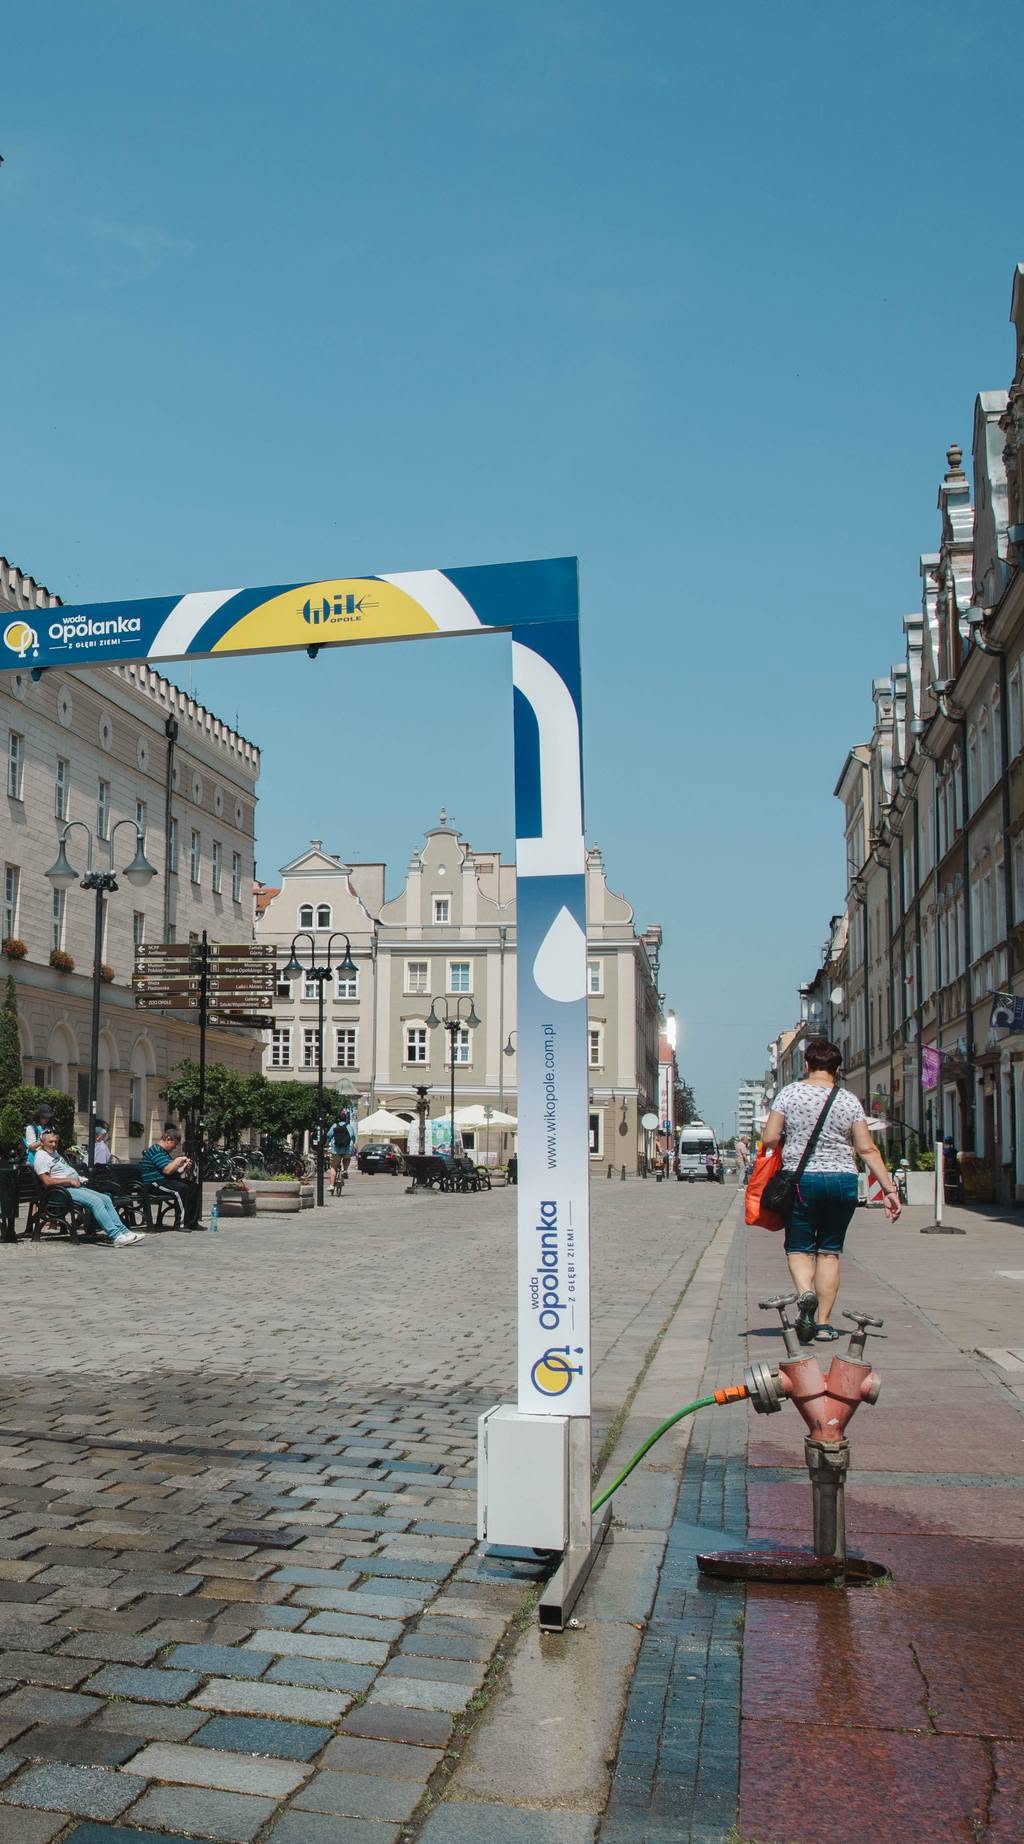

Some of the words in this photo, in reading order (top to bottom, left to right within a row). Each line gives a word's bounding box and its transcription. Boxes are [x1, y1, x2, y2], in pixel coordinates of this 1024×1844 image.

[62, 614, 86, 624] woda
[330, 616, 362, 624] OPOLE
[99, 638, 121, 647] ZIEMI
[541, 1023, 558, 1170] www.wikopole.com.pl
[567, 1228, 575, 1258] ZIEMI
[567, 1262, 577, 1292] GŁĘBI
[528, 1276, 540, 1310] woda
